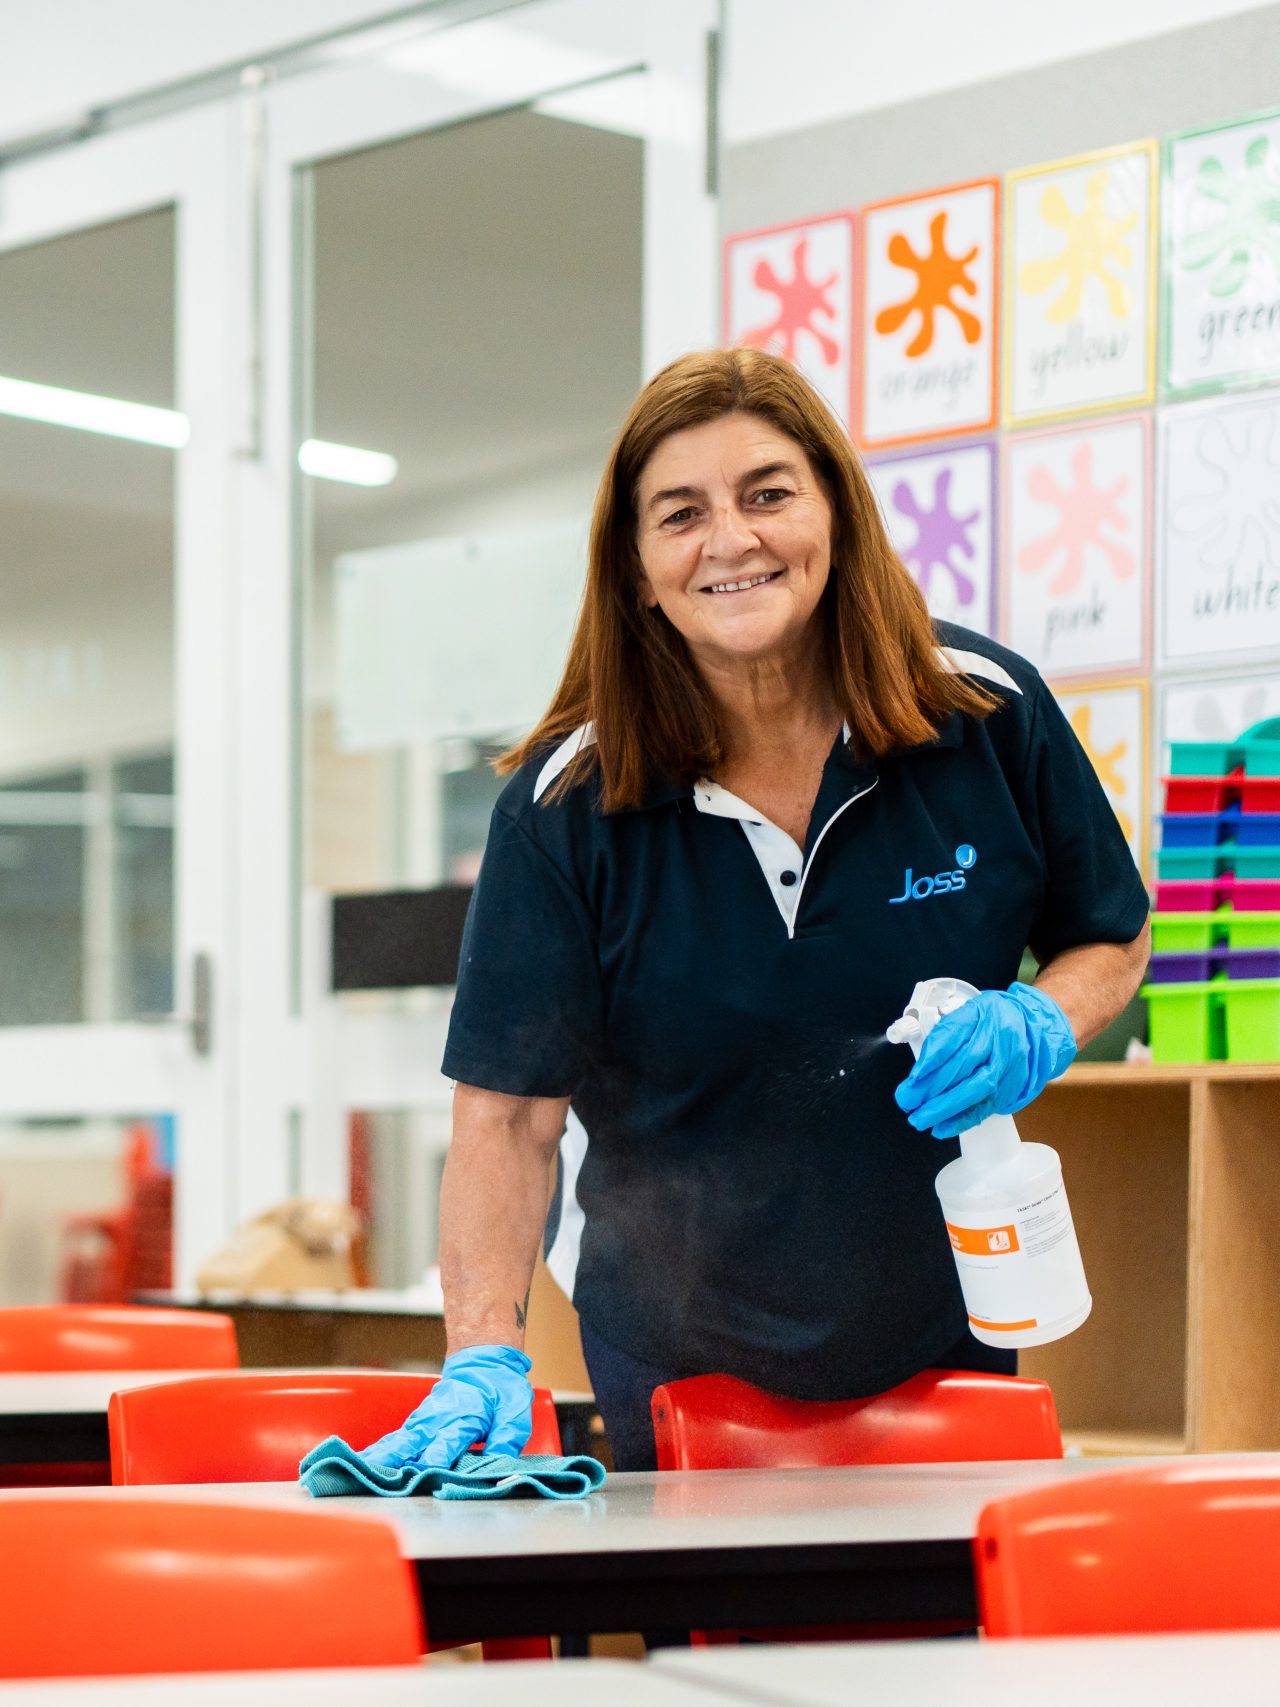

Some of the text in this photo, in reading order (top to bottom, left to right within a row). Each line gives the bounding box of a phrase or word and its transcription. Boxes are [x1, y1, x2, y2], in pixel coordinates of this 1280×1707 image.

[882, 358, 976, 414] orange
[1031, 320, 1129, 399] yellow
[1192, 560, 1280, 617] white
[1042, 587, 1106, 658] pink
[889, 868, 967, 904] Joss
